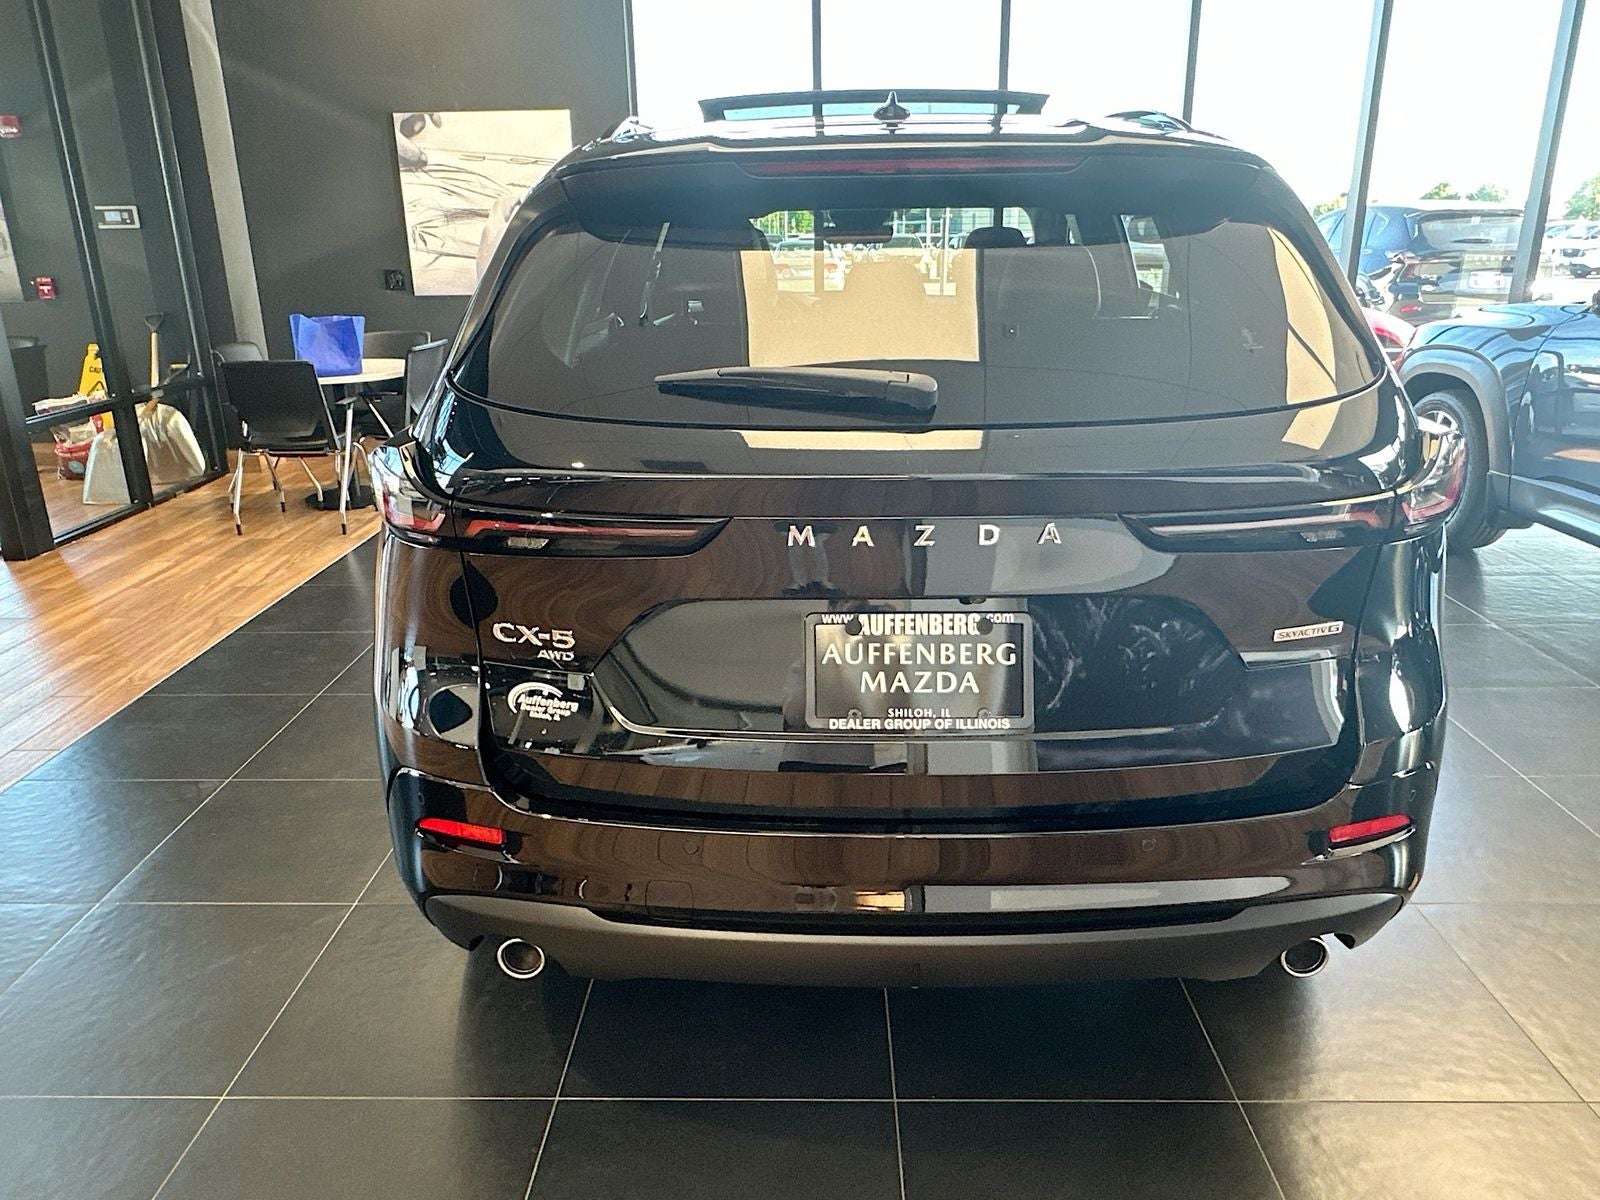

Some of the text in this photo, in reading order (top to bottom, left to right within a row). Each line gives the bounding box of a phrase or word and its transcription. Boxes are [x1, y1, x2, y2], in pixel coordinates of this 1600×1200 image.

[787, 522, 1062, 547] MAZDA
[492, 622, 576, 649] CX-5
[858, 613, 981, 636] AUFFENBERG
[537, 649, 575, 661] AWD
[821, 643, 1017, 666] AUFFENBERG
[860, 671, 980, 694] MAZDA
[829, 717, 1011, 730] DEALER GROUP OF ILLINOIS
[887, 708, 951, 719] SHILOH, IL
